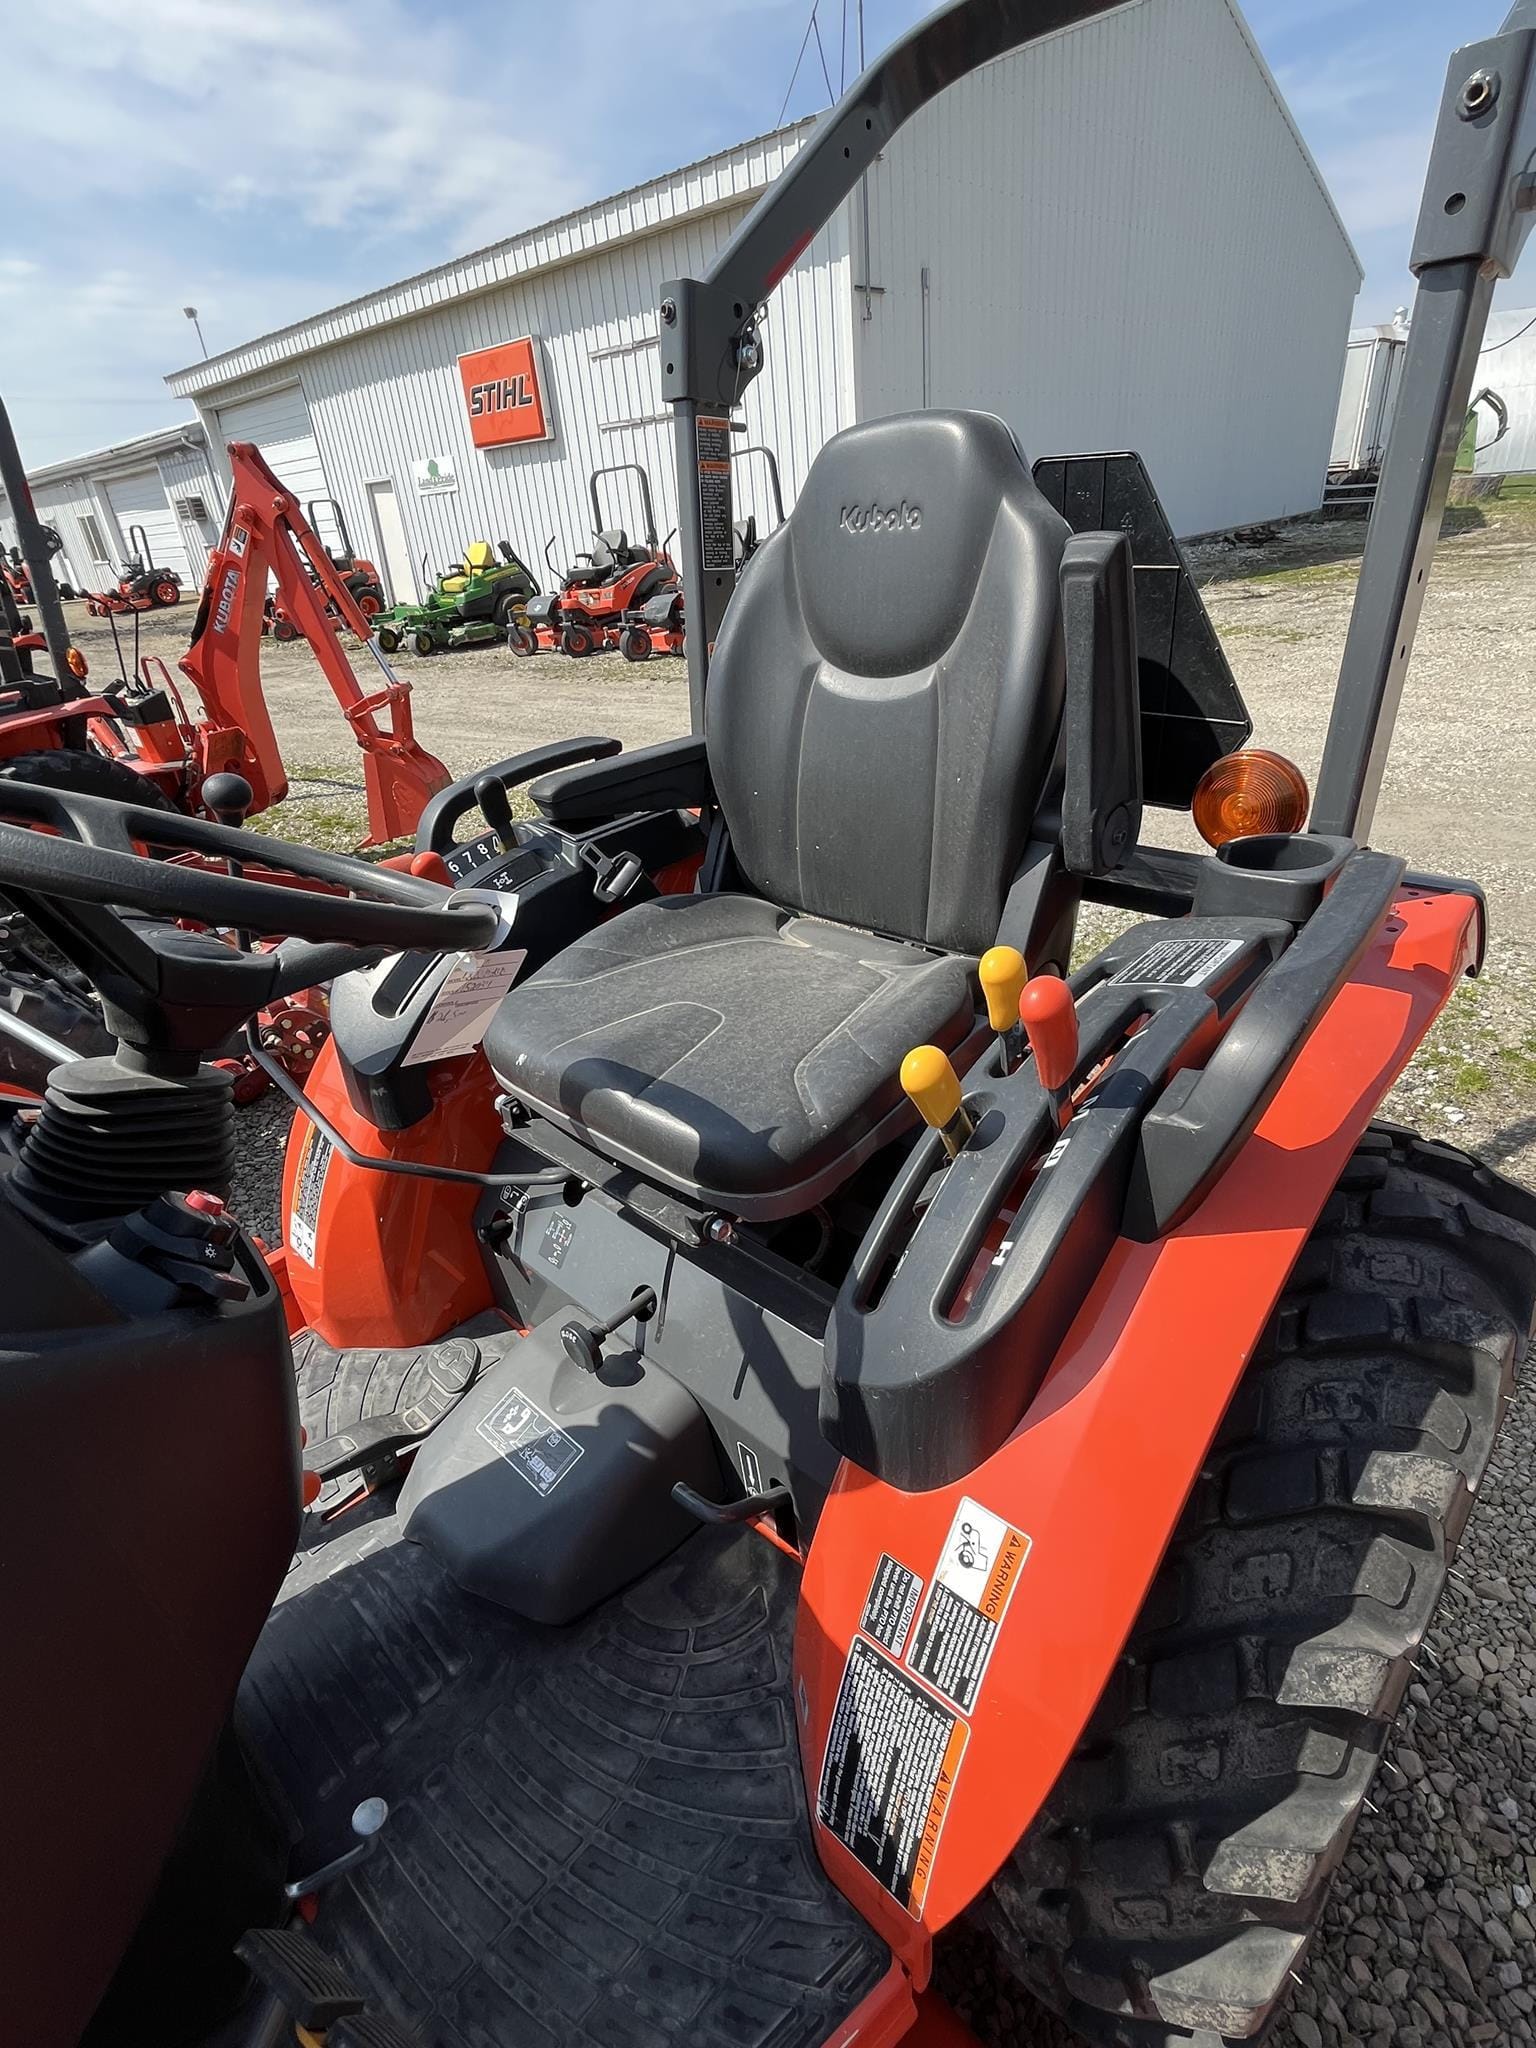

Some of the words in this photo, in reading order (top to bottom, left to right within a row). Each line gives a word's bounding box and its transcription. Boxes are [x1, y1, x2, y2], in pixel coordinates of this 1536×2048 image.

[470, 374, 534, 417] STIHL
[839, 499, 922, 534] Kubota
[213, 568, 242, 635] KUBOTA
[448, 861, 460, 873] 6
[462, 851, 472, 863] 7
[477, 843, 488, 855] 8
[985, 1548, 1015, 1616] WARNING
[894, 1586, 918, 1648] IMPORTANT
[915, 1785, 947, 1882] WARNING
